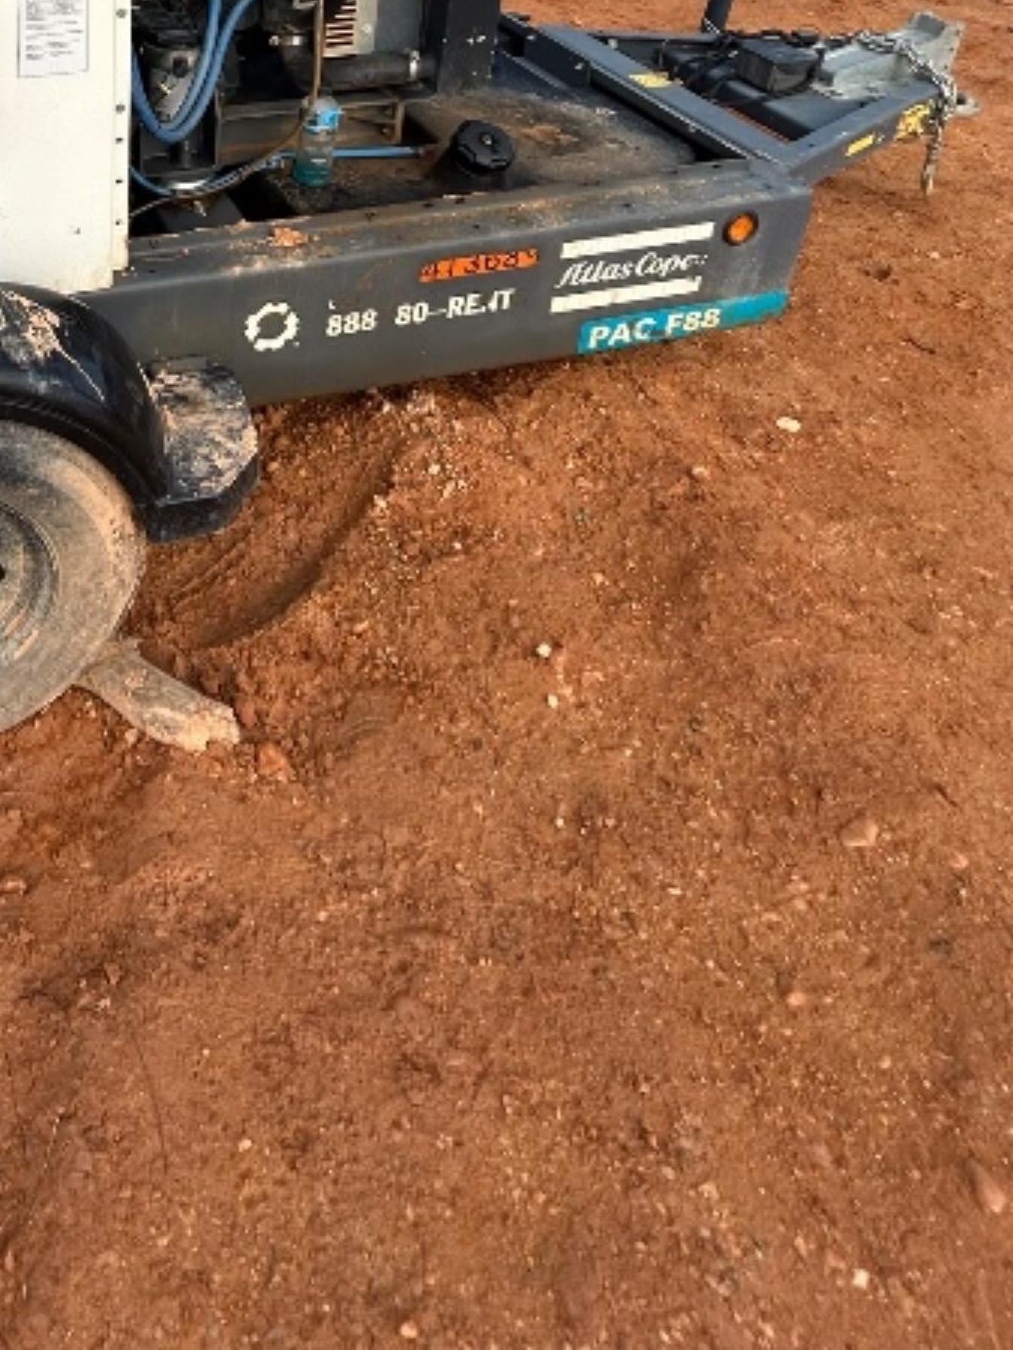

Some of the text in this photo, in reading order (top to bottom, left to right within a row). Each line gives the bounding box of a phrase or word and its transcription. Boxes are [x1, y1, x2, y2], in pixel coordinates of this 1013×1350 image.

[554, 259, 633, 288] Atlas
[325, 308, 378, 337] 888
[587, 308, 721, 349] PAC F88
